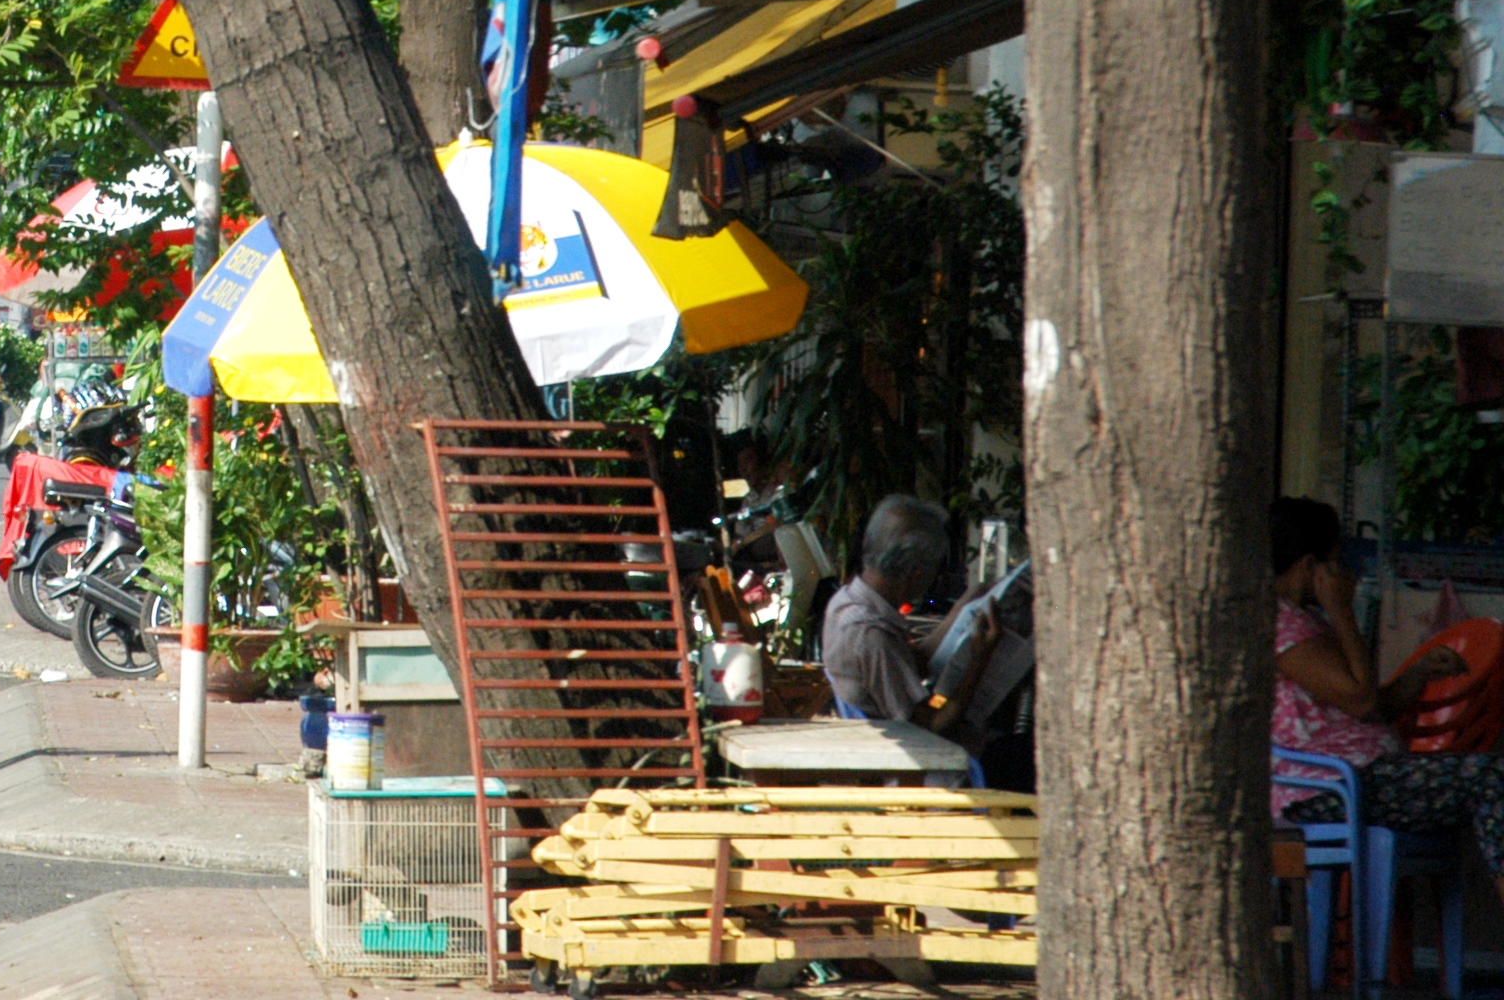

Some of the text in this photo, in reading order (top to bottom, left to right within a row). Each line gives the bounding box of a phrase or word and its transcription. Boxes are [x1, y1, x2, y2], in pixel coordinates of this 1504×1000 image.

[225, 244, 268, 280] BIERE
[532, 270, 585, 289] LARUE
[201, 274, 245, 312] LARUE
